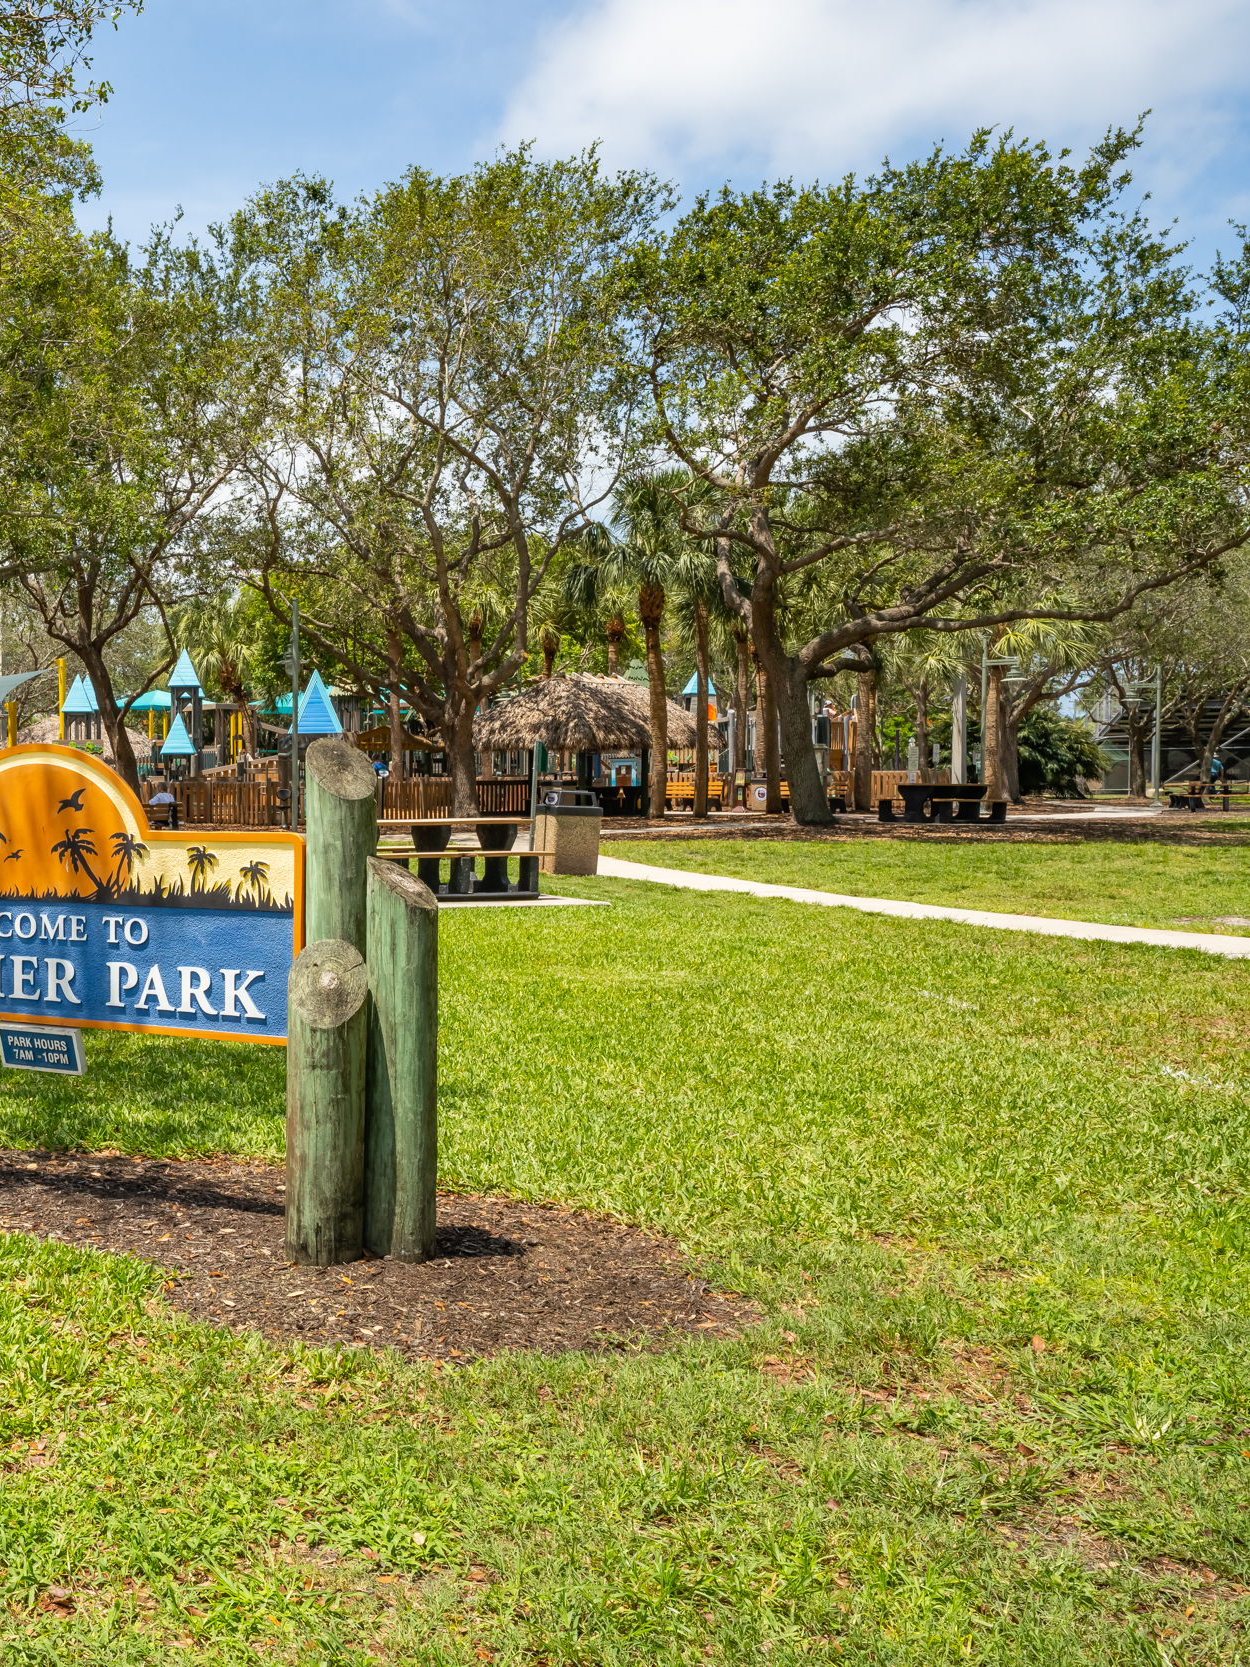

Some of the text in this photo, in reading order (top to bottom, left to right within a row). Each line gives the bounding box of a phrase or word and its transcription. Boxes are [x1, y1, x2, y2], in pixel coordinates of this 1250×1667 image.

[102, 916, 149, 945] TO
[106, 962, 267, 1019] PARK
[7, 1035, 68, 1052] PARK HOURS
[13, 1049, 34, 1061] 7AM
